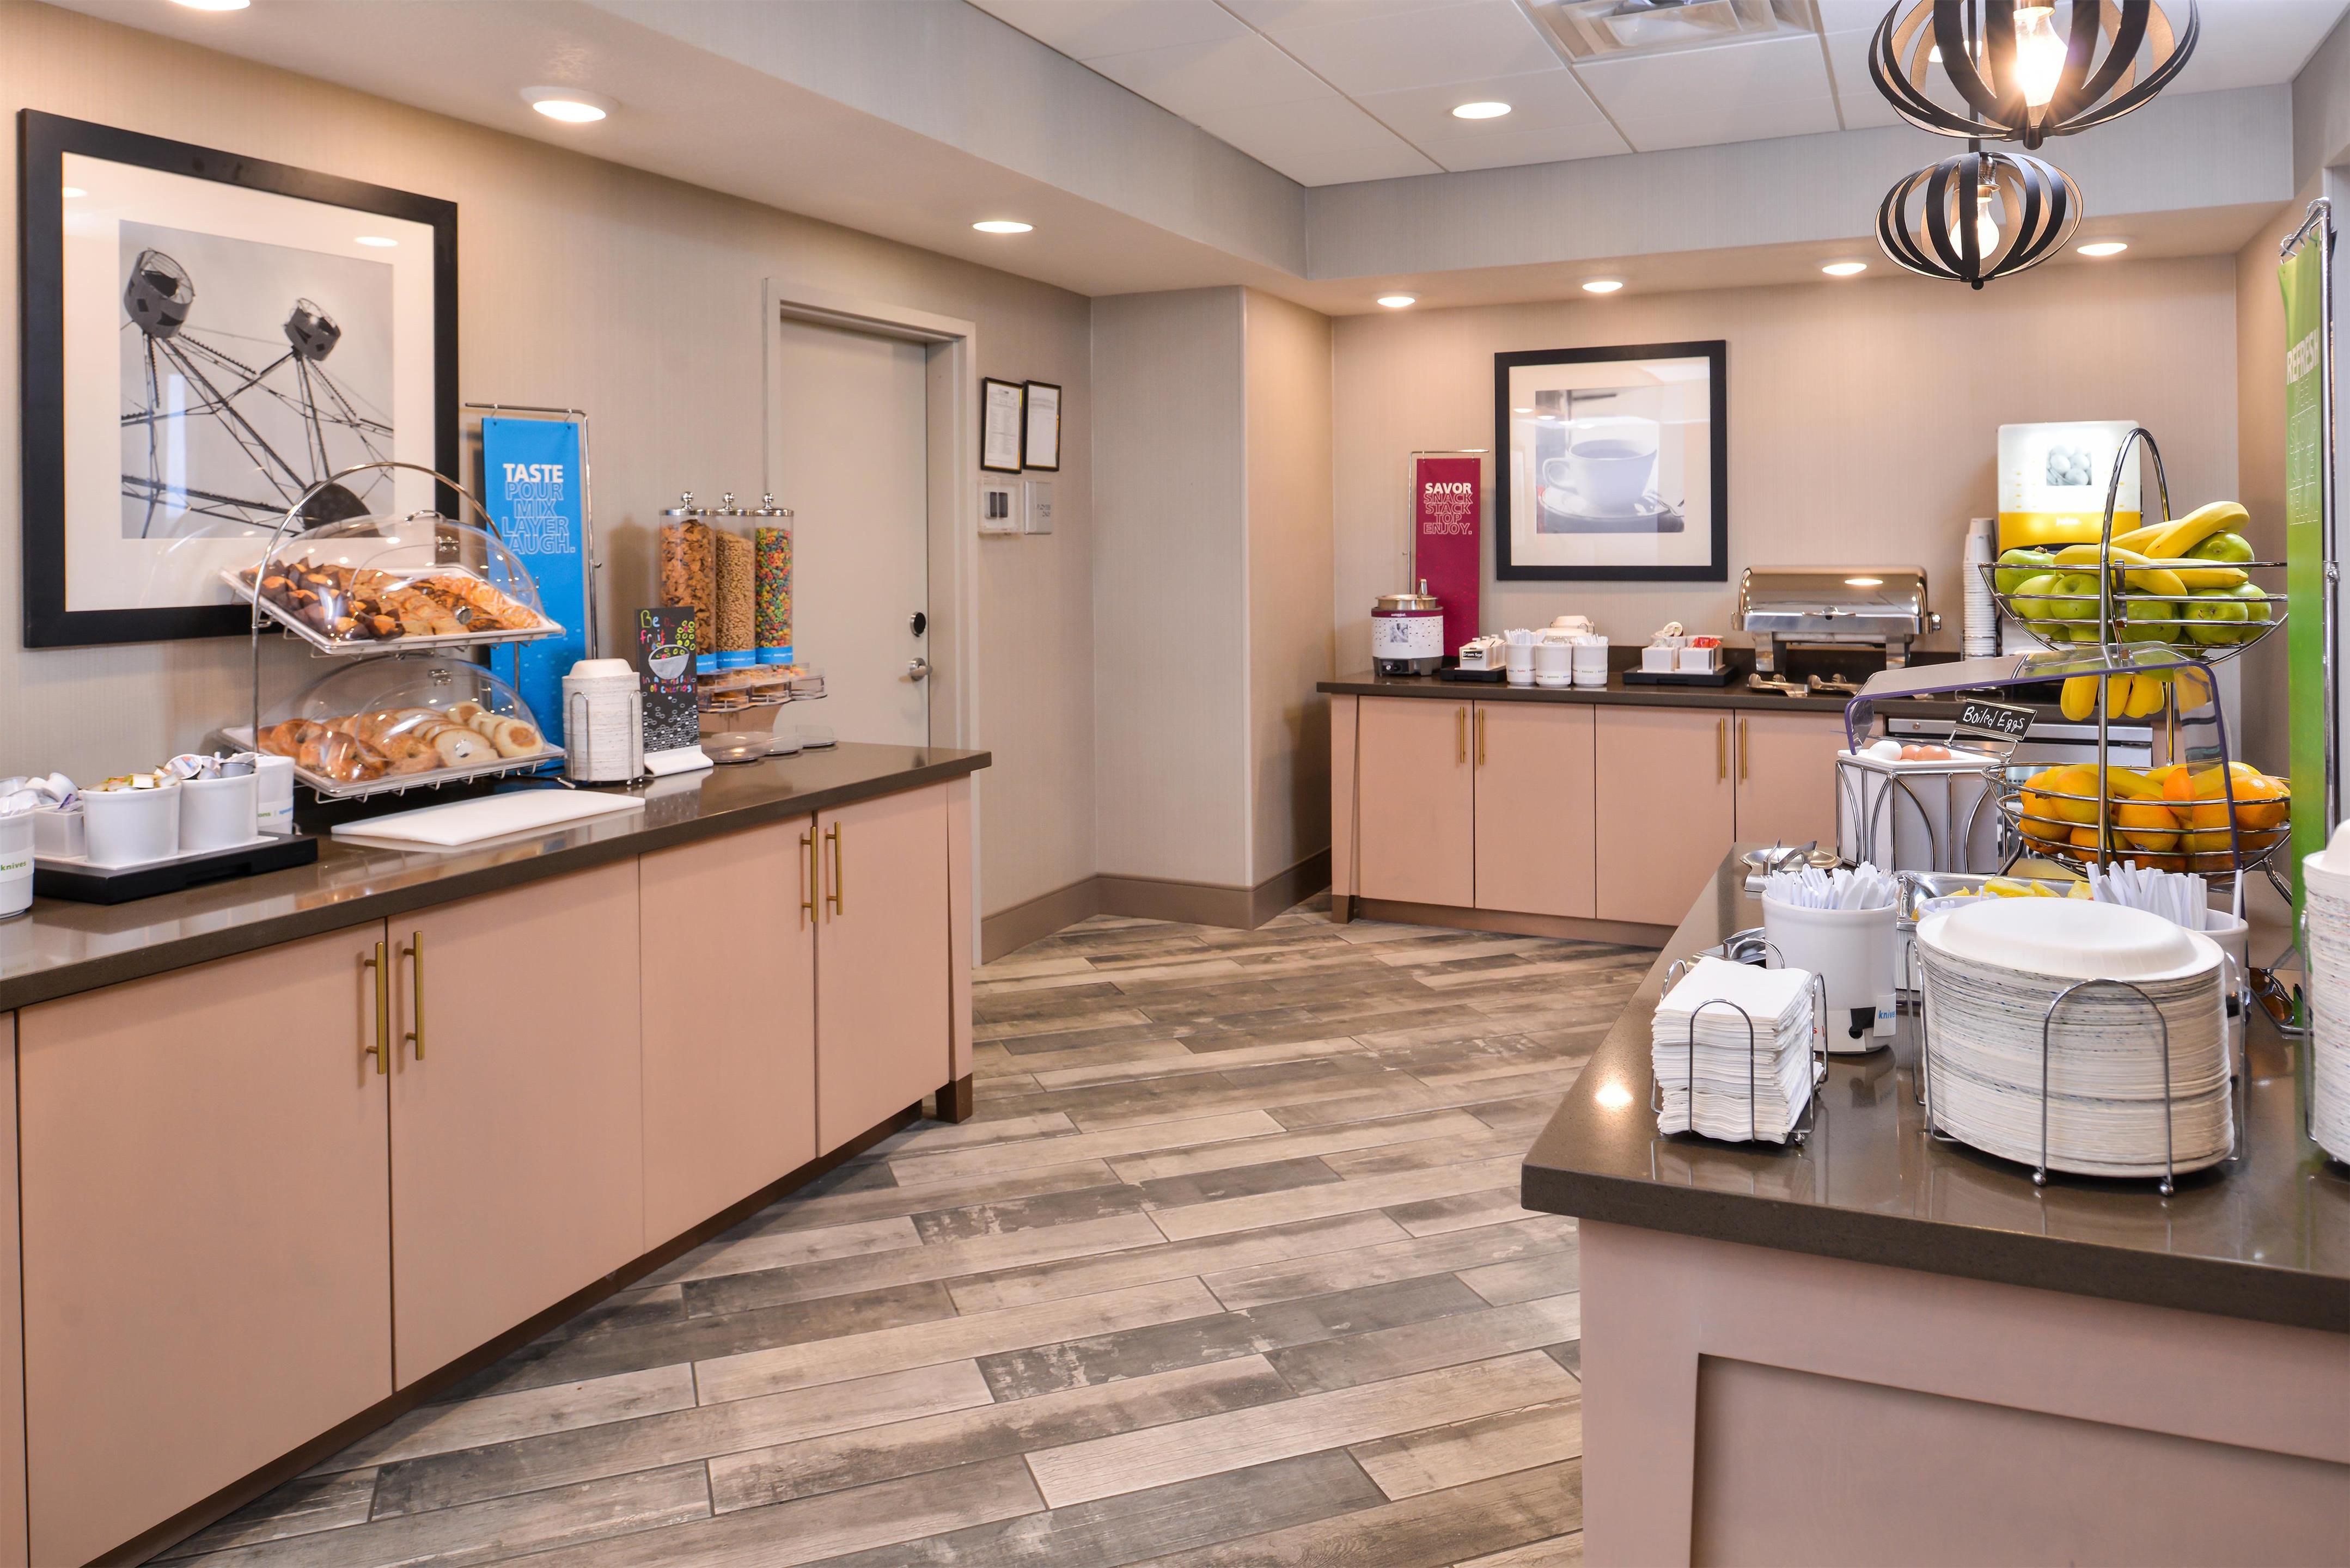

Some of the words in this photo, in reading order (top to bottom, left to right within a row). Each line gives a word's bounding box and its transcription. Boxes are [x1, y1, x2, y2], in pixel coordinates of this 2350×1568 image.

[2287, 327, 2318, 384] REFRESH
[503, 463, 564, 483] TASTE
[505, 481, 564, 500] POUR
[1425, 482, 1472, 494] SAVOR
[1424, 493, 1473, 504] SNACK
[513, 498, 556, 518] MIX
[1425, 503, 1471, 514] STACK
[502, 516, 569, 537] LAYER
[1435, 513, 1462, 524] TOP
[1424, 523, 1472, 535] ENJOY.
[508, 534, 576, 554] AUGH.
[640, 610, 660, 628] Be
[1962, 706, 1999, 728] Boiled
[1997, 711, 2025, 733] Eggs
[1, 861, 27, 871] knives
